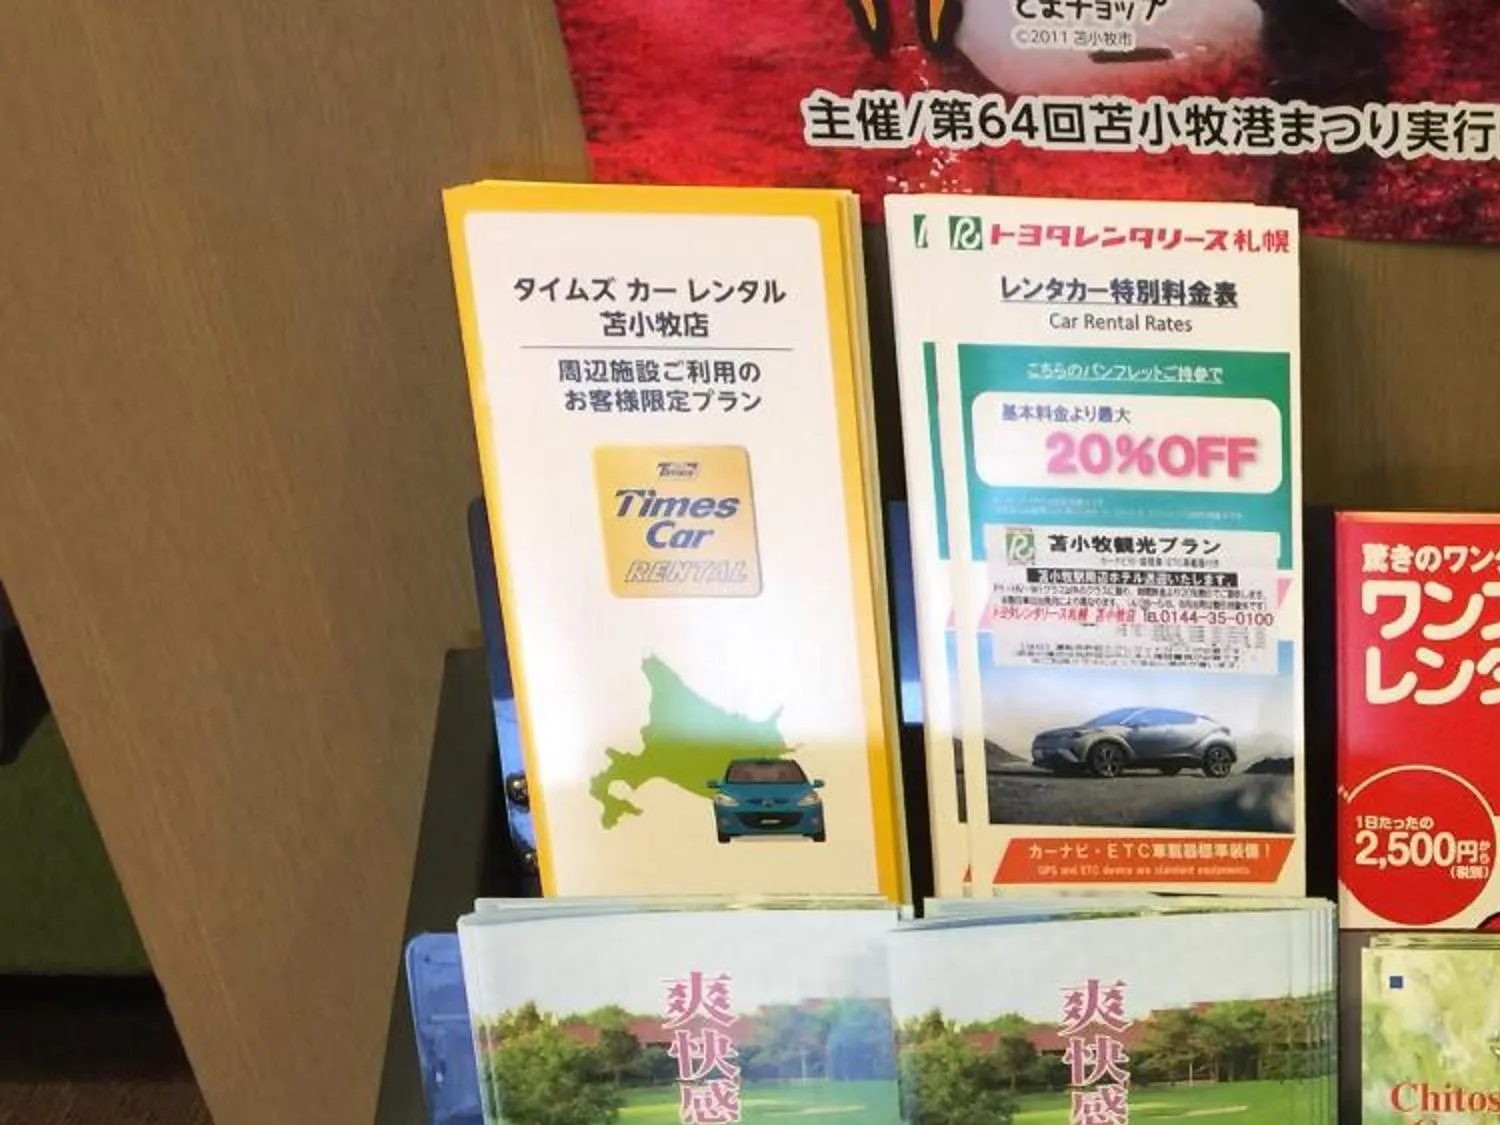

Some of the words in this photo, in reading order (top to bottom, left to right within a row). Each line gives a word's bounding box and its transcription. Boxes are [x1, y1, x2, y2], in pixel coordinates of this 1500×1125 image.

[989, 222, 1291, 254] トヨタレンタリース札幌
[513, 277, 615, 303] タイムズ
[627, 278, 677, 303] カー
[688, 278, 787, 305] レンタル
[1000, 276, 1239, 307] レンタカー特別料金表
[600, 311, 710, 339] 苫小牧店
[1049, 312, 1079, 330] Car
[1083, 312, 1140, 331] Rental
[1144, 314, 1193, 333] Rates
[557, 359, 762, 385] 周辺施設ご利用の
[564, 389, 762, 414] お客様限定プラン
[1001, 403, 1131, 423] 基本料金より最大
[1044, 430, 1258, 479] 20%OFF
[615, 488, 740, 519] Times
[646, 520, 716, 550] Car
[1047, 533, 1222, 556] 苫小牧観光プラン
[624, 559, 748, 584] RENTAL
[1355, 815, 1434, 831] 1日たったの
